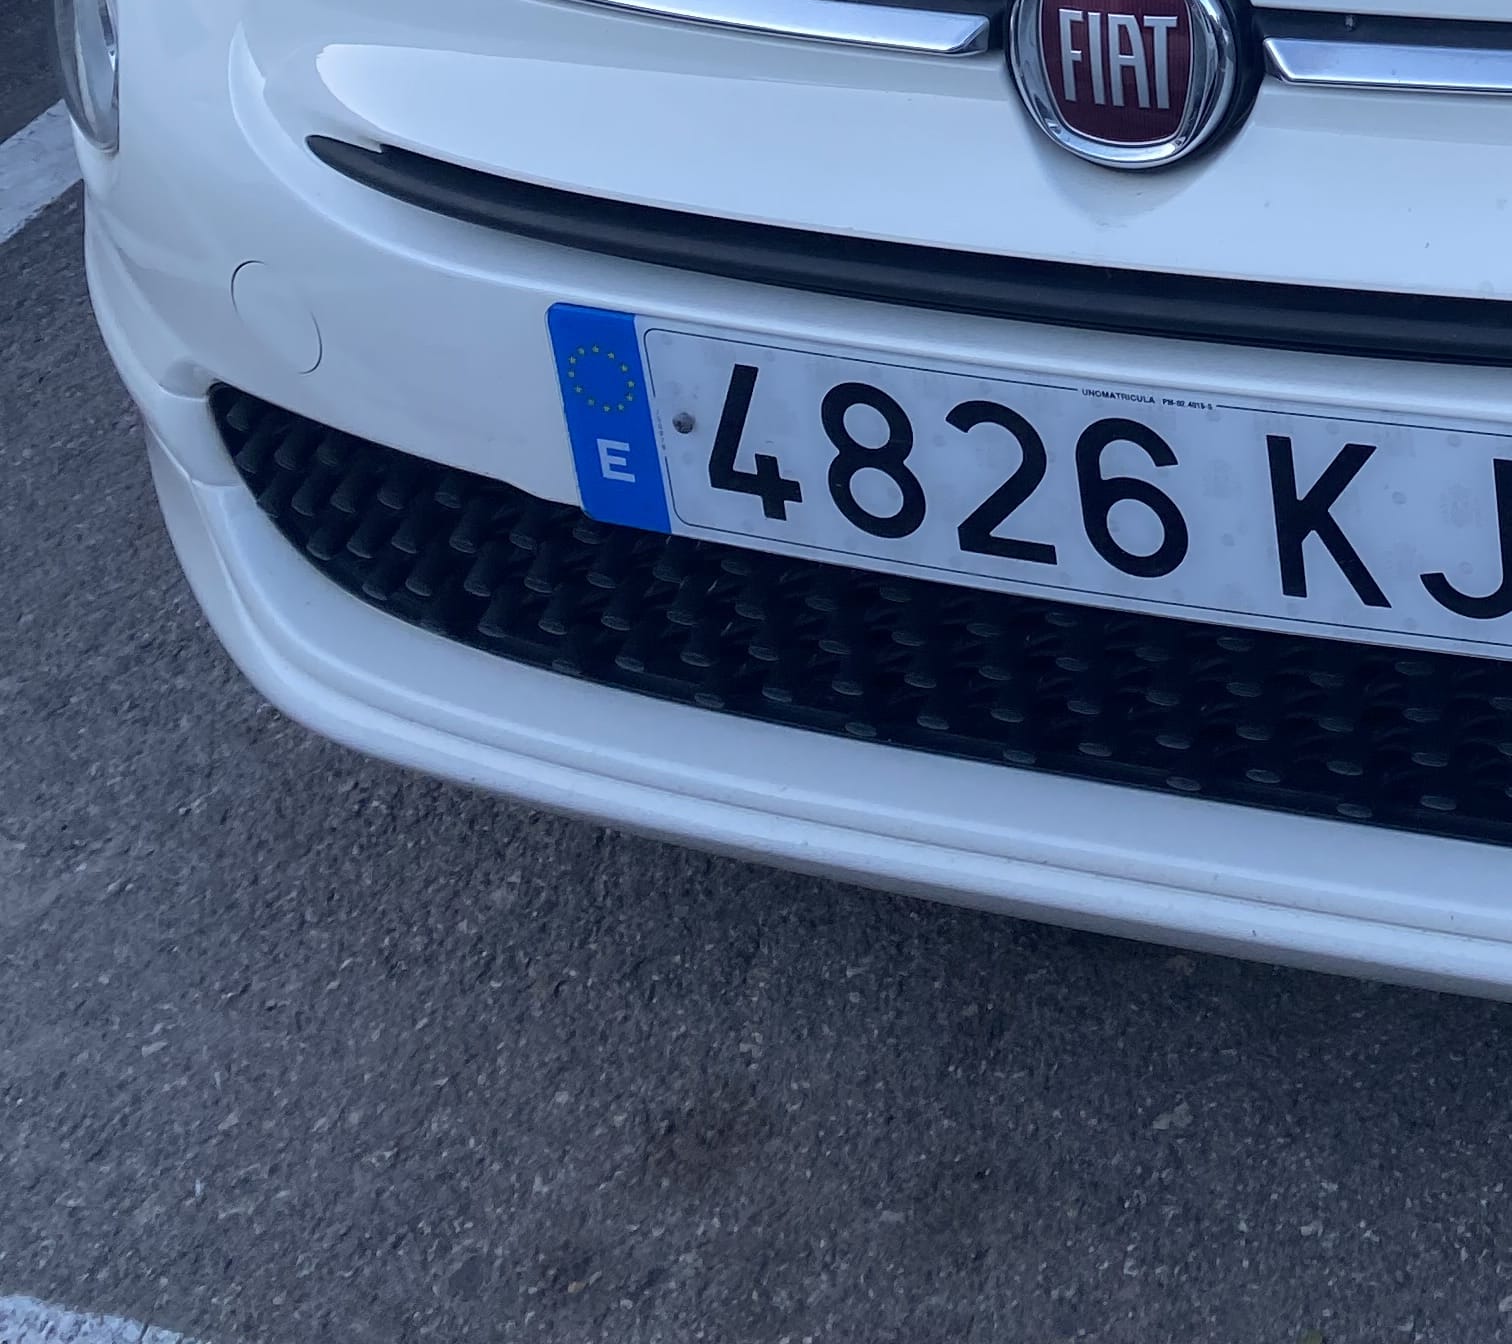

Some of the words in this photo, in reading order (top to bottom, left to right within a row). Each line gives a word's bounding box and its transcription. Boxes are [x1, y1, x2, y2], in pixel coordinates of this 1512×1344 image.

[1058, 8, 1178, 110] FIAT
[1082, 388, 1155, 404] UNOMATRICULA
[597, 438, 635, 483] E
[708, 363, 1190, 580] 4826
